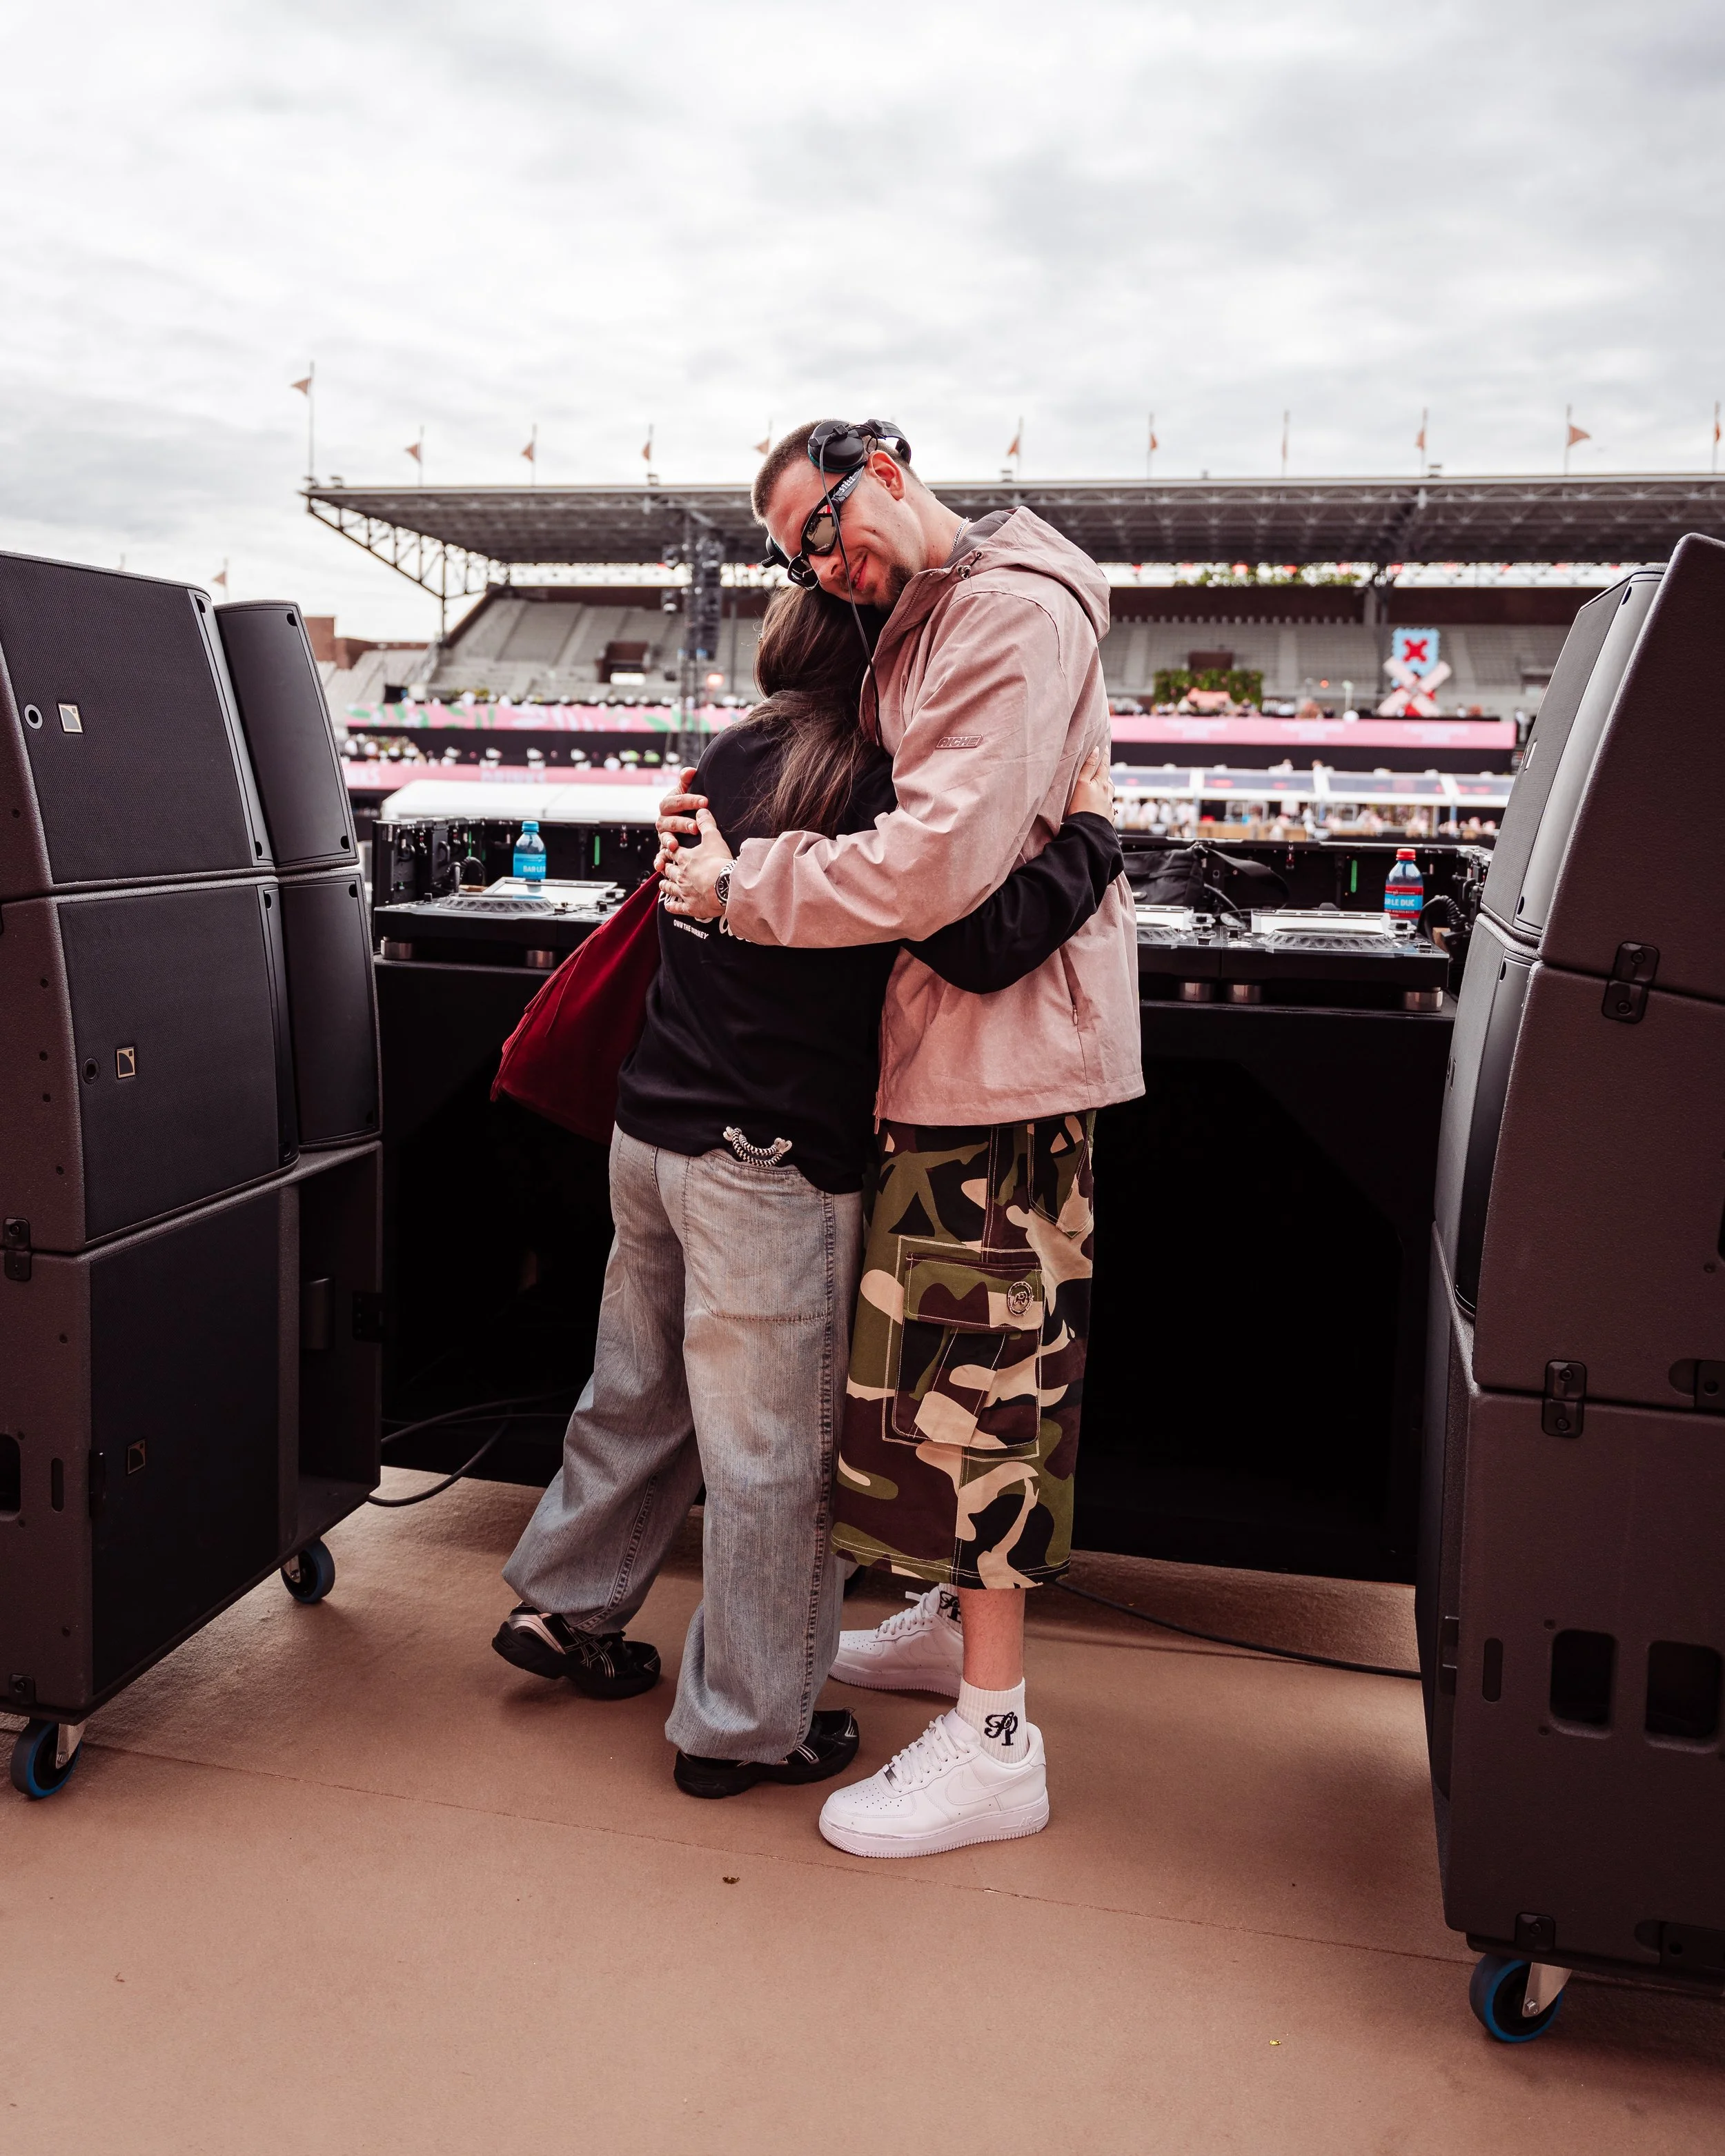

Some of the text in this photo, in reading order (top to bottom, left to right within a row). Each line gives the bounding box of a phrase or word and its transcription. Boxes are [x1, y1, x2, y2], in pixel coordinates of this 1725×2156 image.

[839, 475, 856, 493] STËLZ
[1391, 898, 1399, 907] LE
[1400, 899, 1415, 907] DUC
[673, 919, 683, 929] OWN
[683, 923, 691, 932] THE
